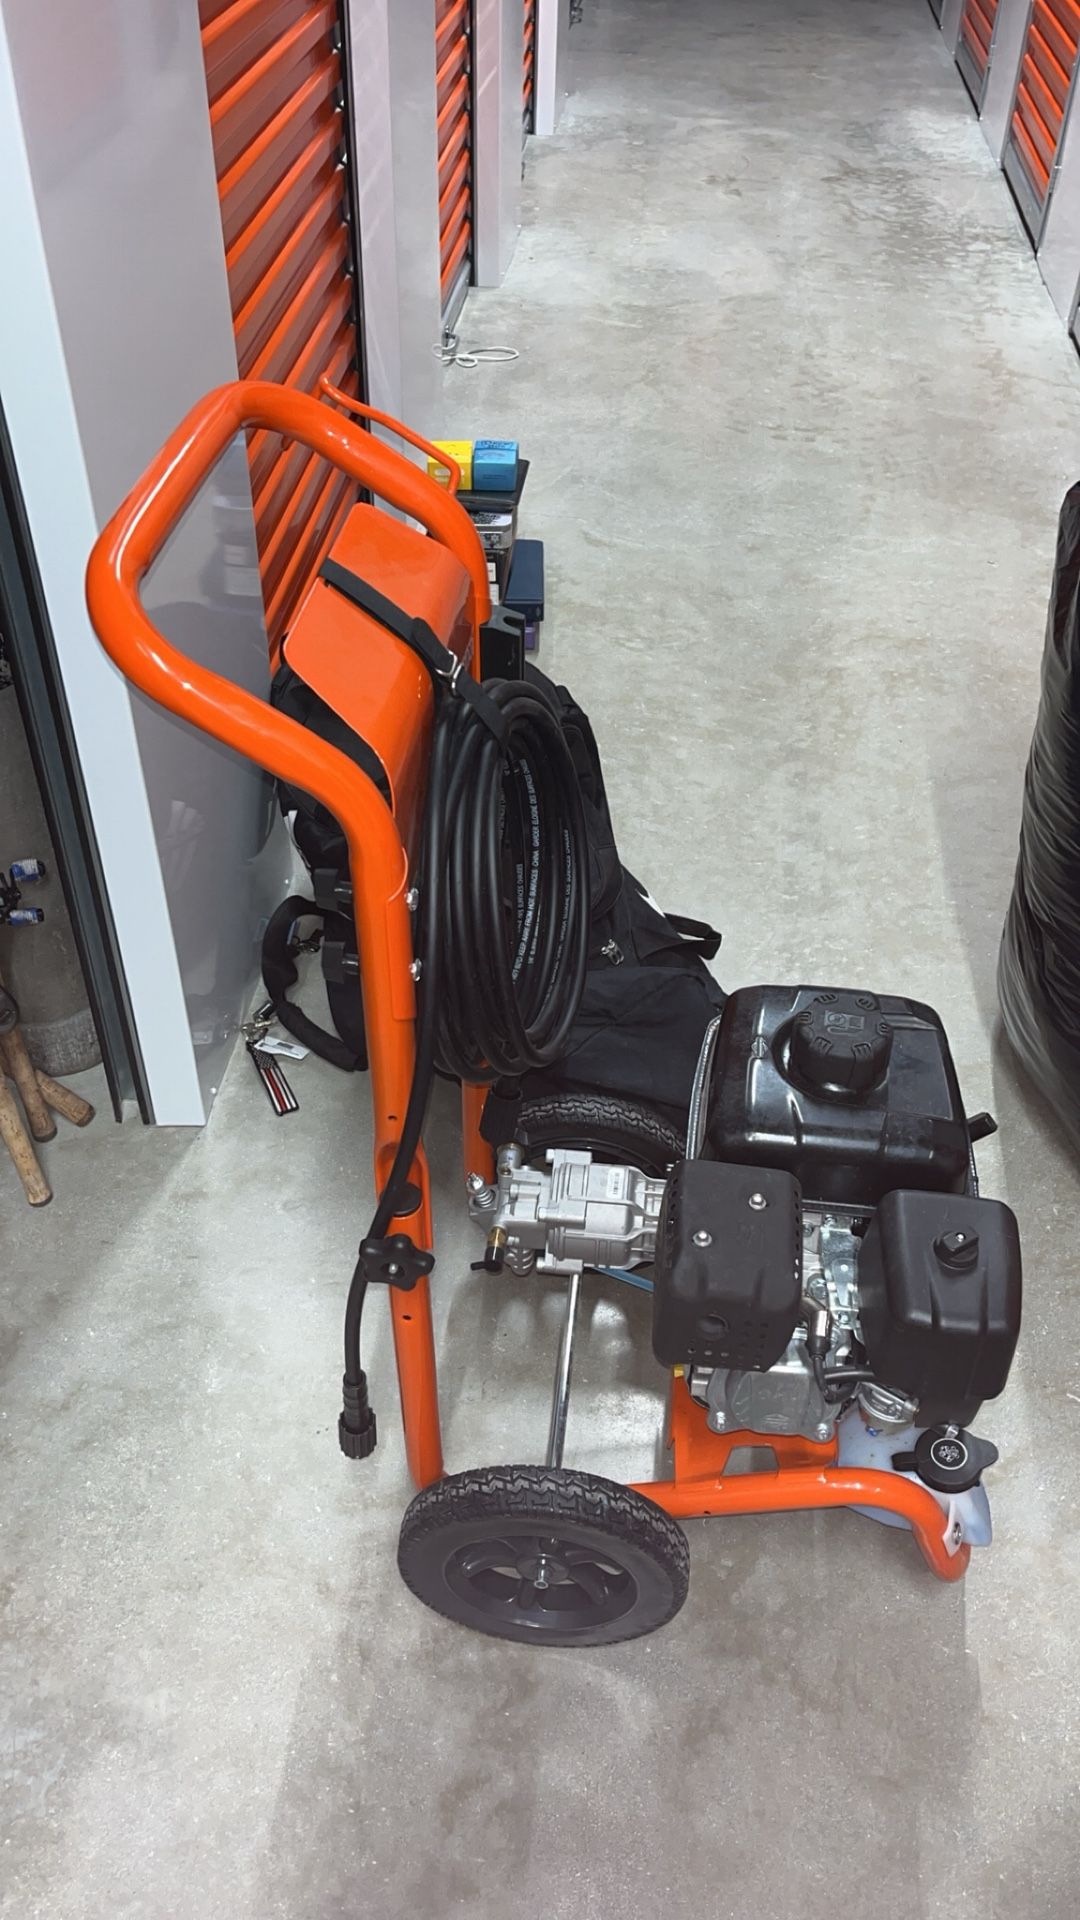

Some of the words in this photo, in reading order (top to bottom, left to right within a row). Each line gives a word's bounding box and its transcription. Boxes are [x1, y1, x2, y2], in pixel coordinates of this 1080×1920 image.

[524, 774, 535, 793] SURFACES
[529, 795, 537, 804] DES
[529, 869, 538, 897] SURFACES
[527, 897, 535, 910] HOT
[525, 910, 533, 926] FROM
